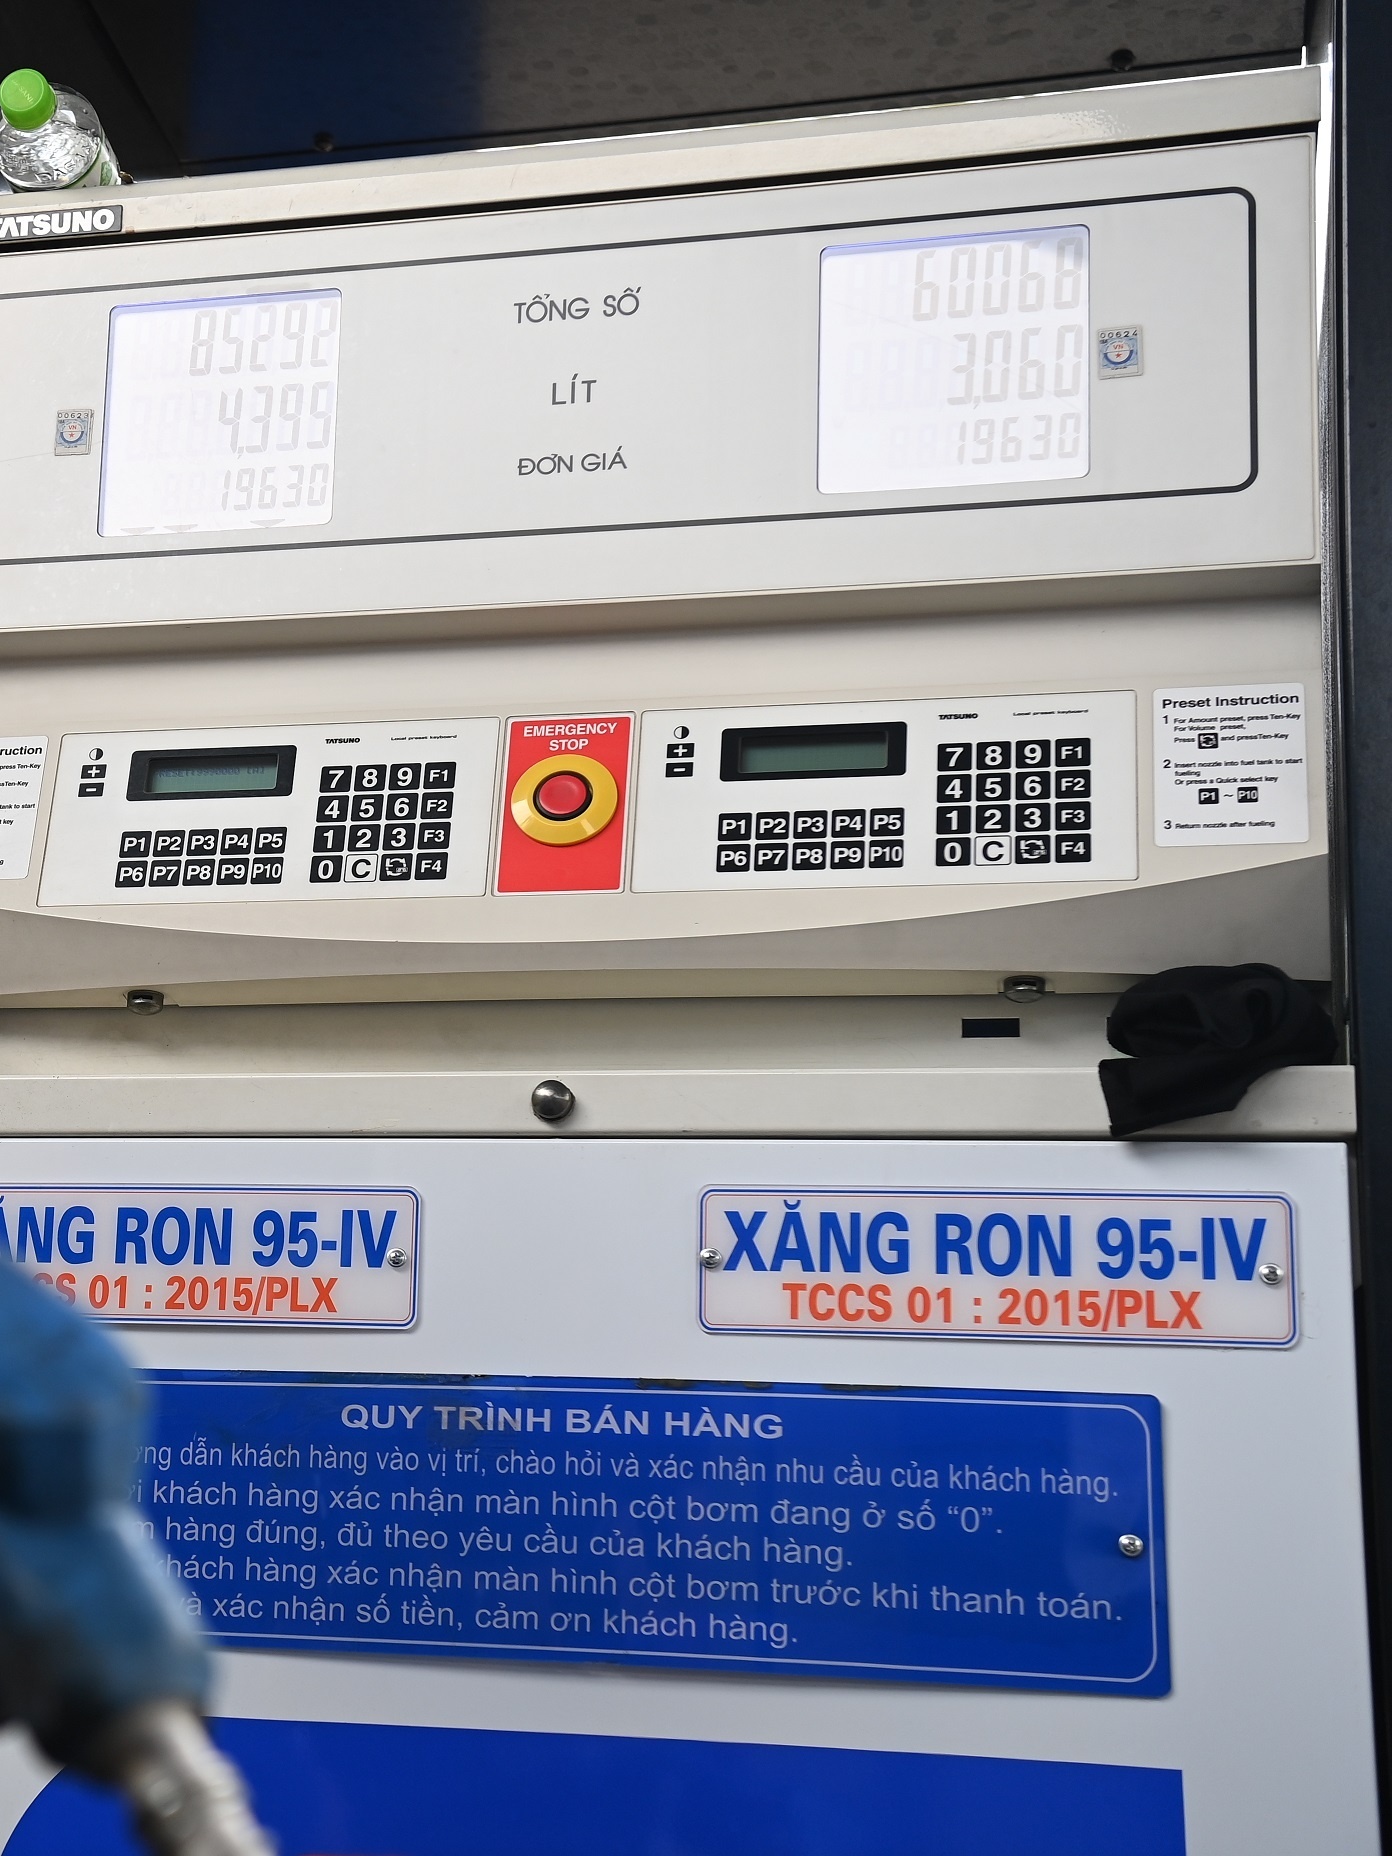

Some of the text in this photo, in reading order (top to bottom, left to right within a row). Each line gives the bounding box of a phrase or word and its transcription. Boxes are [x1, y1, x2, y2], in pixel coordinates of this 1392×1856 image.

[514, 286, 642, 325] TỔNG SỐ
[1100, 330, 1138, 338] 00624
[551, 373, 597, 406] LÍT
[958, 413, 1080, 465] 19630
[517, 445, 627, 477] ĐƠN GIÁ
[221, 463, 329, 511] 19630
[1161, 693, 1300, 709] Preset Instruction
[523, 722, 617, 738] EMERGENCY
[549, 738, 589, 751] STOP
[329, 767, 448, 788] 7 8 9 F1
[324, 798, 447, 818] 4 5 6 F2
[323, 828, 444, 848] 1 2 3 F3
[722, 815, 901, 835] P1 P2 P3 P4 P5
[123, 833, 282, 852] P1 P2 P3 P4 P5
[119, 863, 282, 882] P6 P7 P8 P9 P10
[318, 859, 442, 879] 0 C F4
[115, 1207, 231, 1266] RON
[253, 1209, 397, 1268] 95-IV
[723, 1199, 1267, 1281] XĂNG RON 95-IV
[89, 1274, 127, 1309] 01
[144, 1282, 153, 1309] :
[165, 1275, 338, 1315] 2015/PLX
[782, 1282, 1203, 1331] TCCS 01 : 2015/PLX
[341, 1401, 783, 1440] QUY TRÌNH BÁN HÀNG
[180, 1437, 222, 1466] dẫn
[231, 1442, 300, 1468] khách
[309, 1444, 367, 1476] hàng
[376, 1445, 419, 1471] vào
[427, 1447, 446, 1477] vị
[455, 1448, 486, 1477] trí,
[496, 1449, 556, 1475] chào
[565, 1449, 601, 1477] hỏi
[610, 1452, 639, 1478] và
[648, 1453, 694, 1480] xác
[703, 1455, 766, 1486] nhận
[776, 1457, 824, 1484] nhu
[833, 1452, 881, 1487] cầu
[891, 1460, 939, 1489] của
[949, 1463, 1030, 1493] khách
[1041, 1467, 1118, 1502] hàng.
[153, 1479, 237, 1506] khách
[248, 1481, 318, 1515] hàng
[329, 1484, 380, 1510] xác
[391, 1486, 463, 1517] nhận
[475, 1489, 539, 1515] màn
[552, 1490, 617, 1518] hình
[629, 1493, 676, 1524] cột
[687, 1495, 758, 1523] bơm
[770, 1498, 850, 1534] đang
[862, 1501, 886, 1529] ở
[897, 1498, 936, 1531] số
[948, 1505, 1002, 1534] “0”.
[165, 1515, 235, 1549] hàng
[246, 1518, 325, 1552] đúng,
[337, 1520, 372, 1547] đủ
[383, 1523, 448, 1550] theo
[458, 1525, 512, 1557] yêu
[524, 1528, 578, 1555] cầu
[589, 1529, 645, 1558] của
[657, 1531, 751, 1561] khách
[763, 1536, 852, 1573] hàng.
